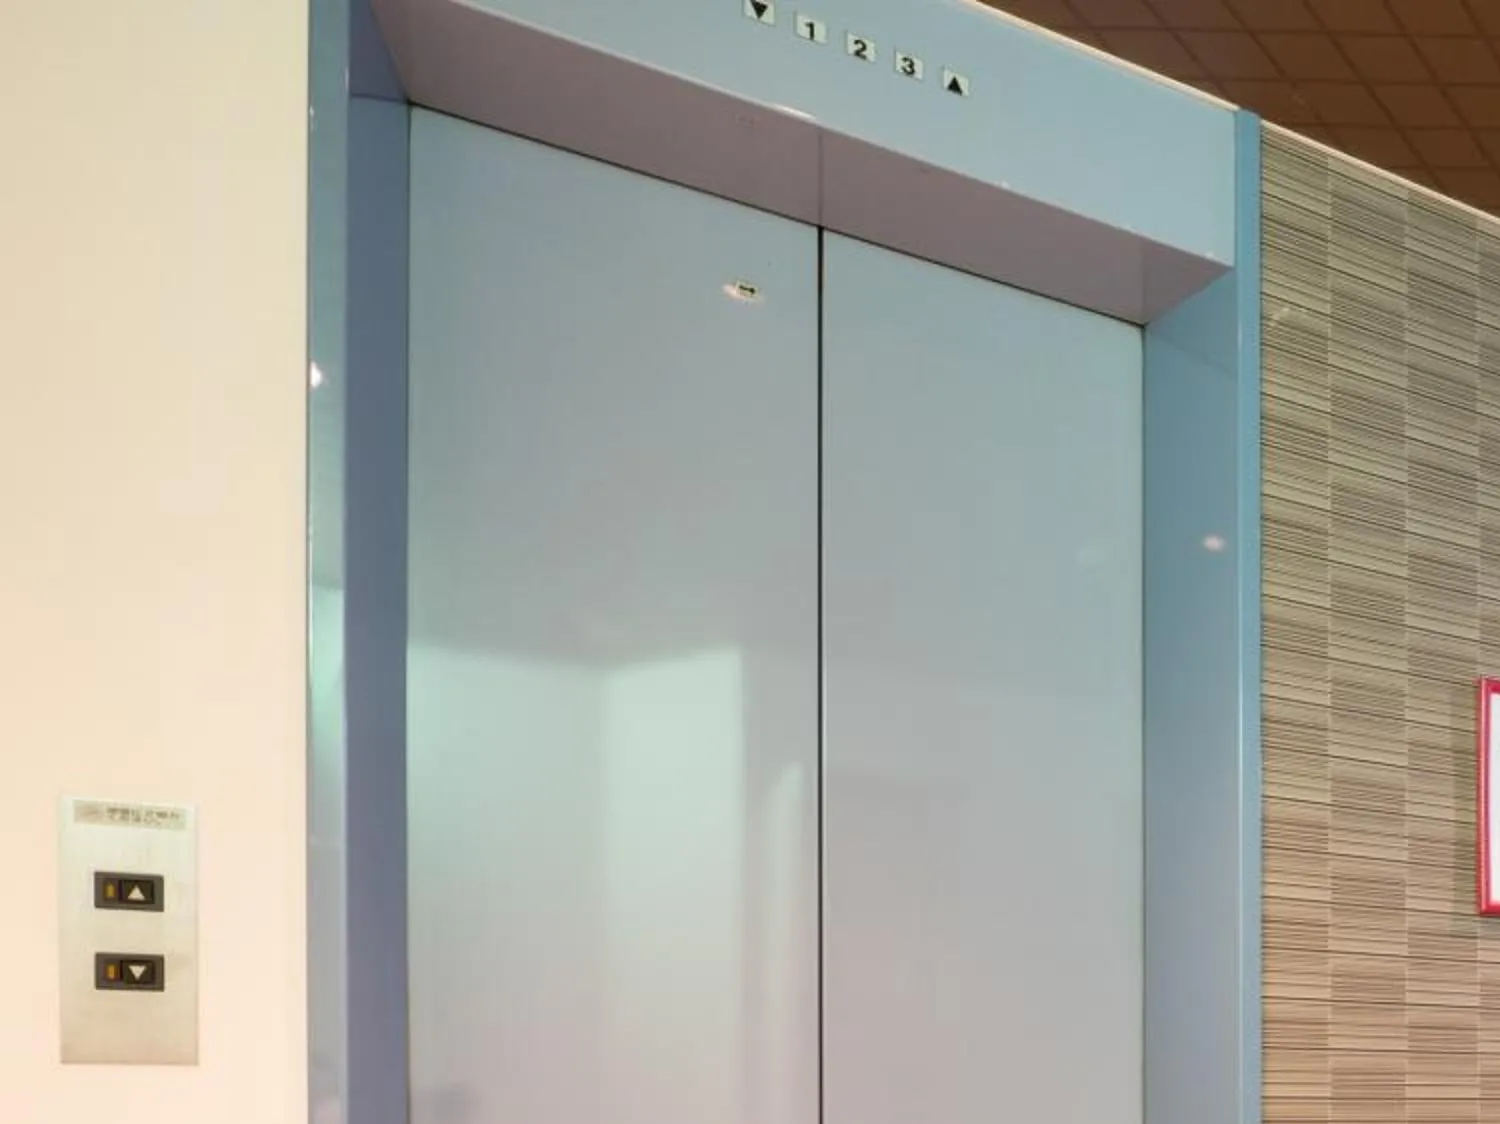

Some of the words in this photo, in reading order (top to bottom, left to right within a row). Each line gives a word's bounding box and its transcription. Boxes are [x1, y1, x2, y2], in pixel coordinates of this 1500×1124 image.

[804, 21, 815, 41] 1
[853, 39, 868, 60] 2
[901, 56, 916, 76] 3
